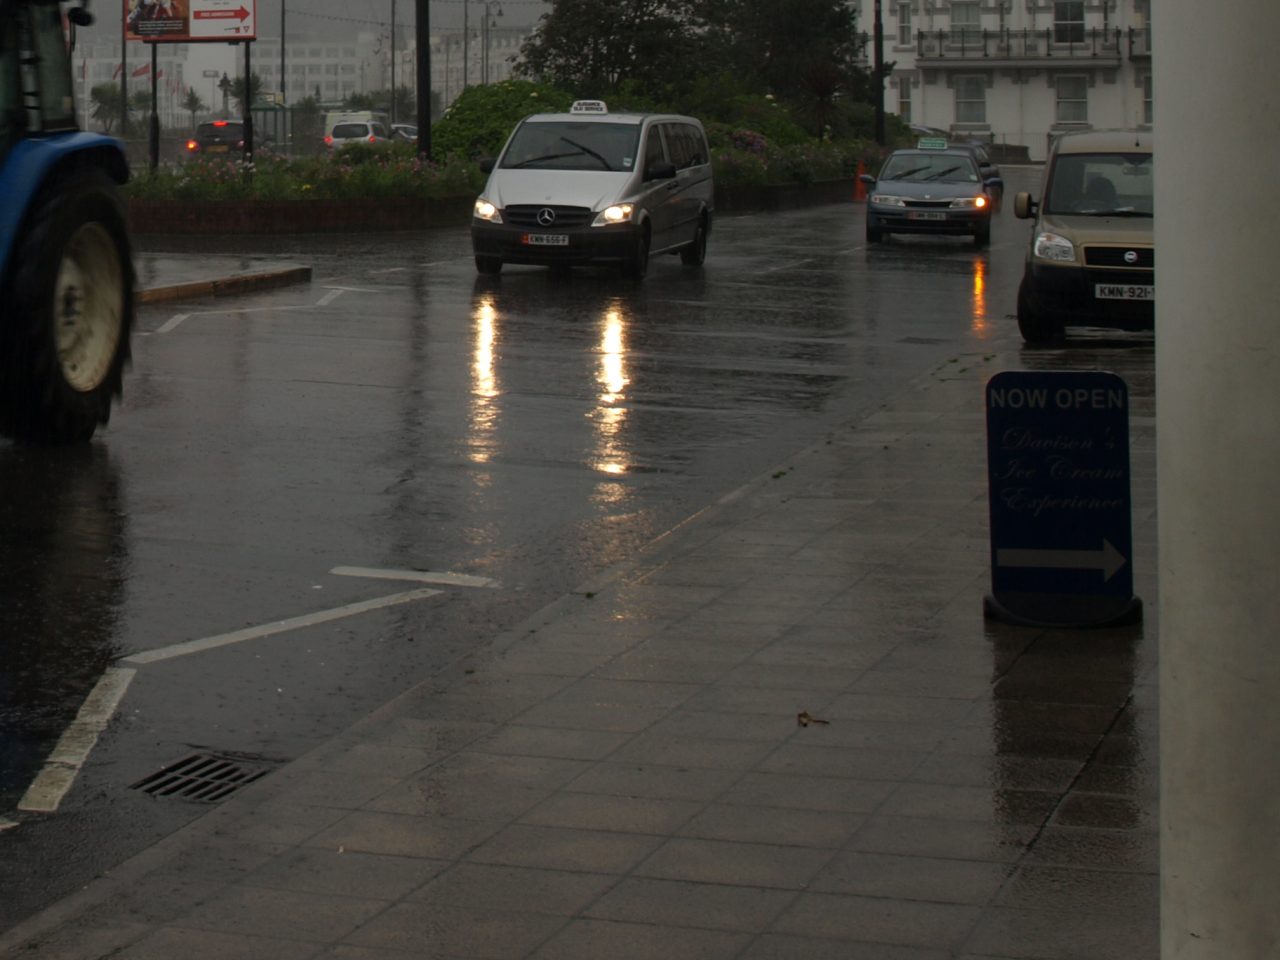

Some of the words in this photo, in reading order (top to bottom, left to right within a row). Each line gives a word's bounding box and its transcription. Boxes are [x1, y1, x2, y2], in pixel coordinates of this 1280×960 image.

[990, 388, 1048, 409] NOW
[1055, 388, 1123, 409] OPEN
[993, 458, 1036, 479] Ice
[1046, 454, 1123, 480] Cream
[1000, 487, 1121, 518] Experience
